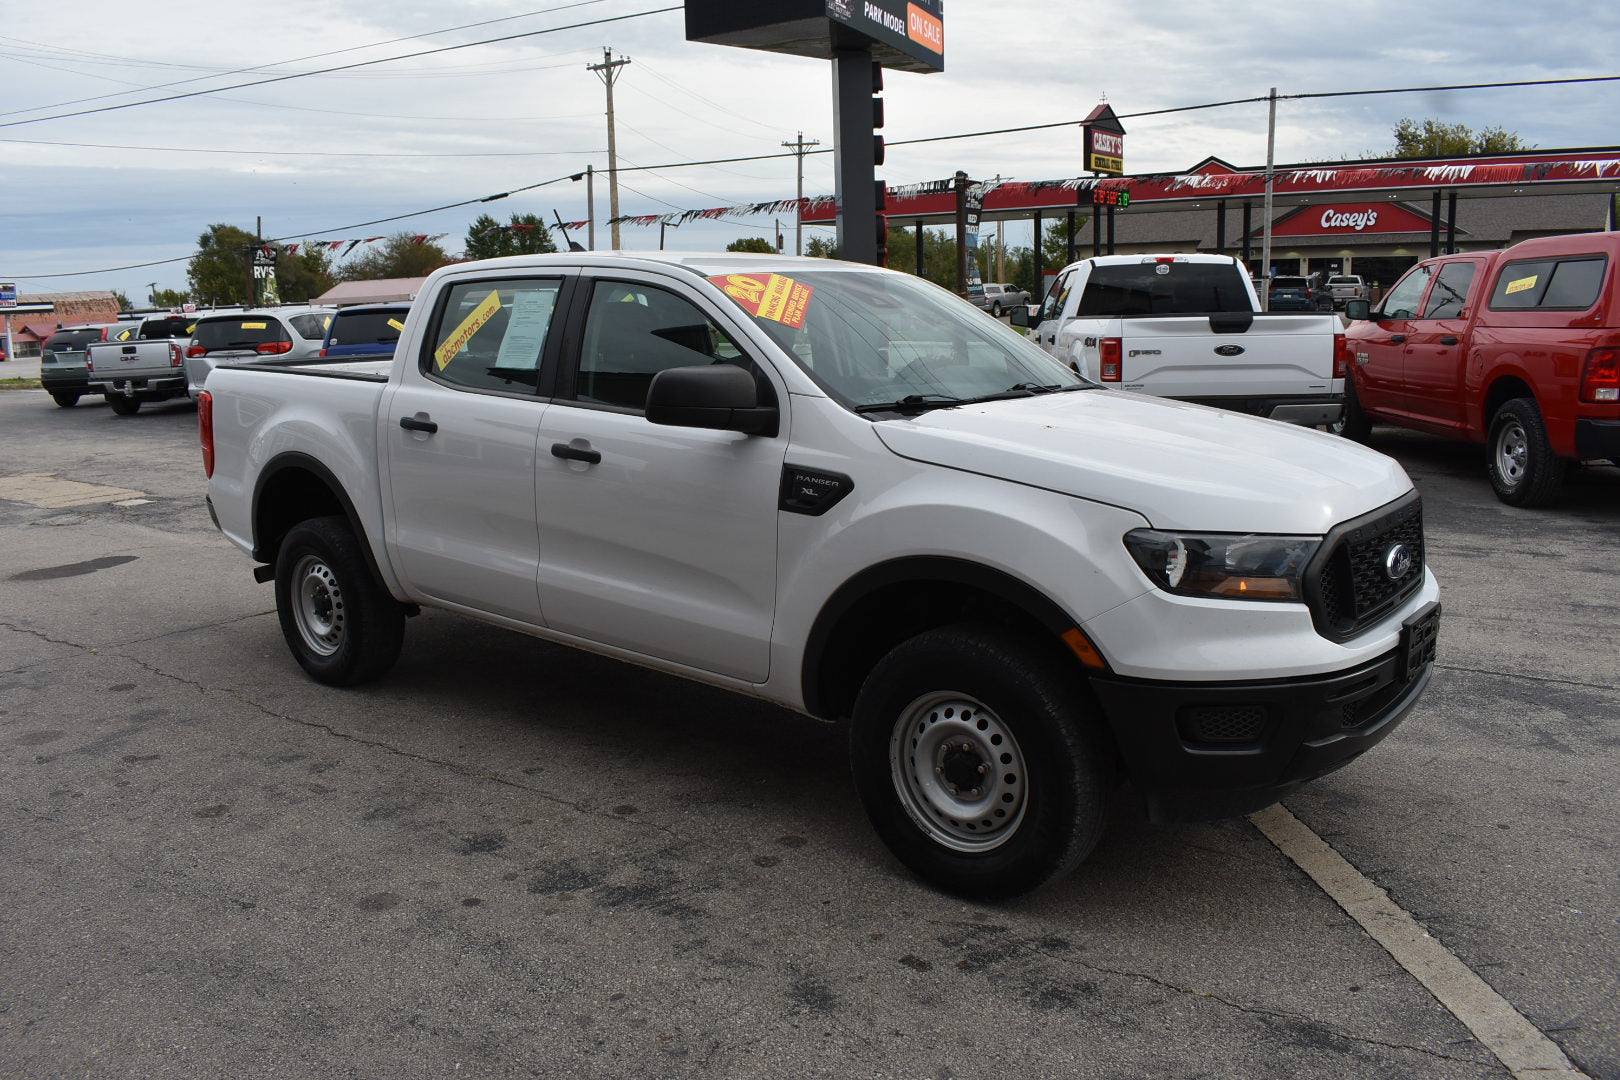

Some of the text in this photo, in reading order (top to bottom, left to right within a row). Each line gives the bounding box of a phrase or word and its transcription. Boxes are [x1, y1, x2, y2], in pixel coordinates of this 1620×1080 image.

[864, 1, 905, 36] PARK MODEL
[910, 13, 940, 44] ON SALE
[1093, 132, 1122, 154] CASEY'S
[1320, 208, 1378, 231] Casey's
[253, 265, 275, 279] RV'S
[724, 275, 765, 304] 20
[792, 308, 802, 324] PLAN
[796, 475, 839, 487] RANGER
[801, 487, 818, 496] XL
